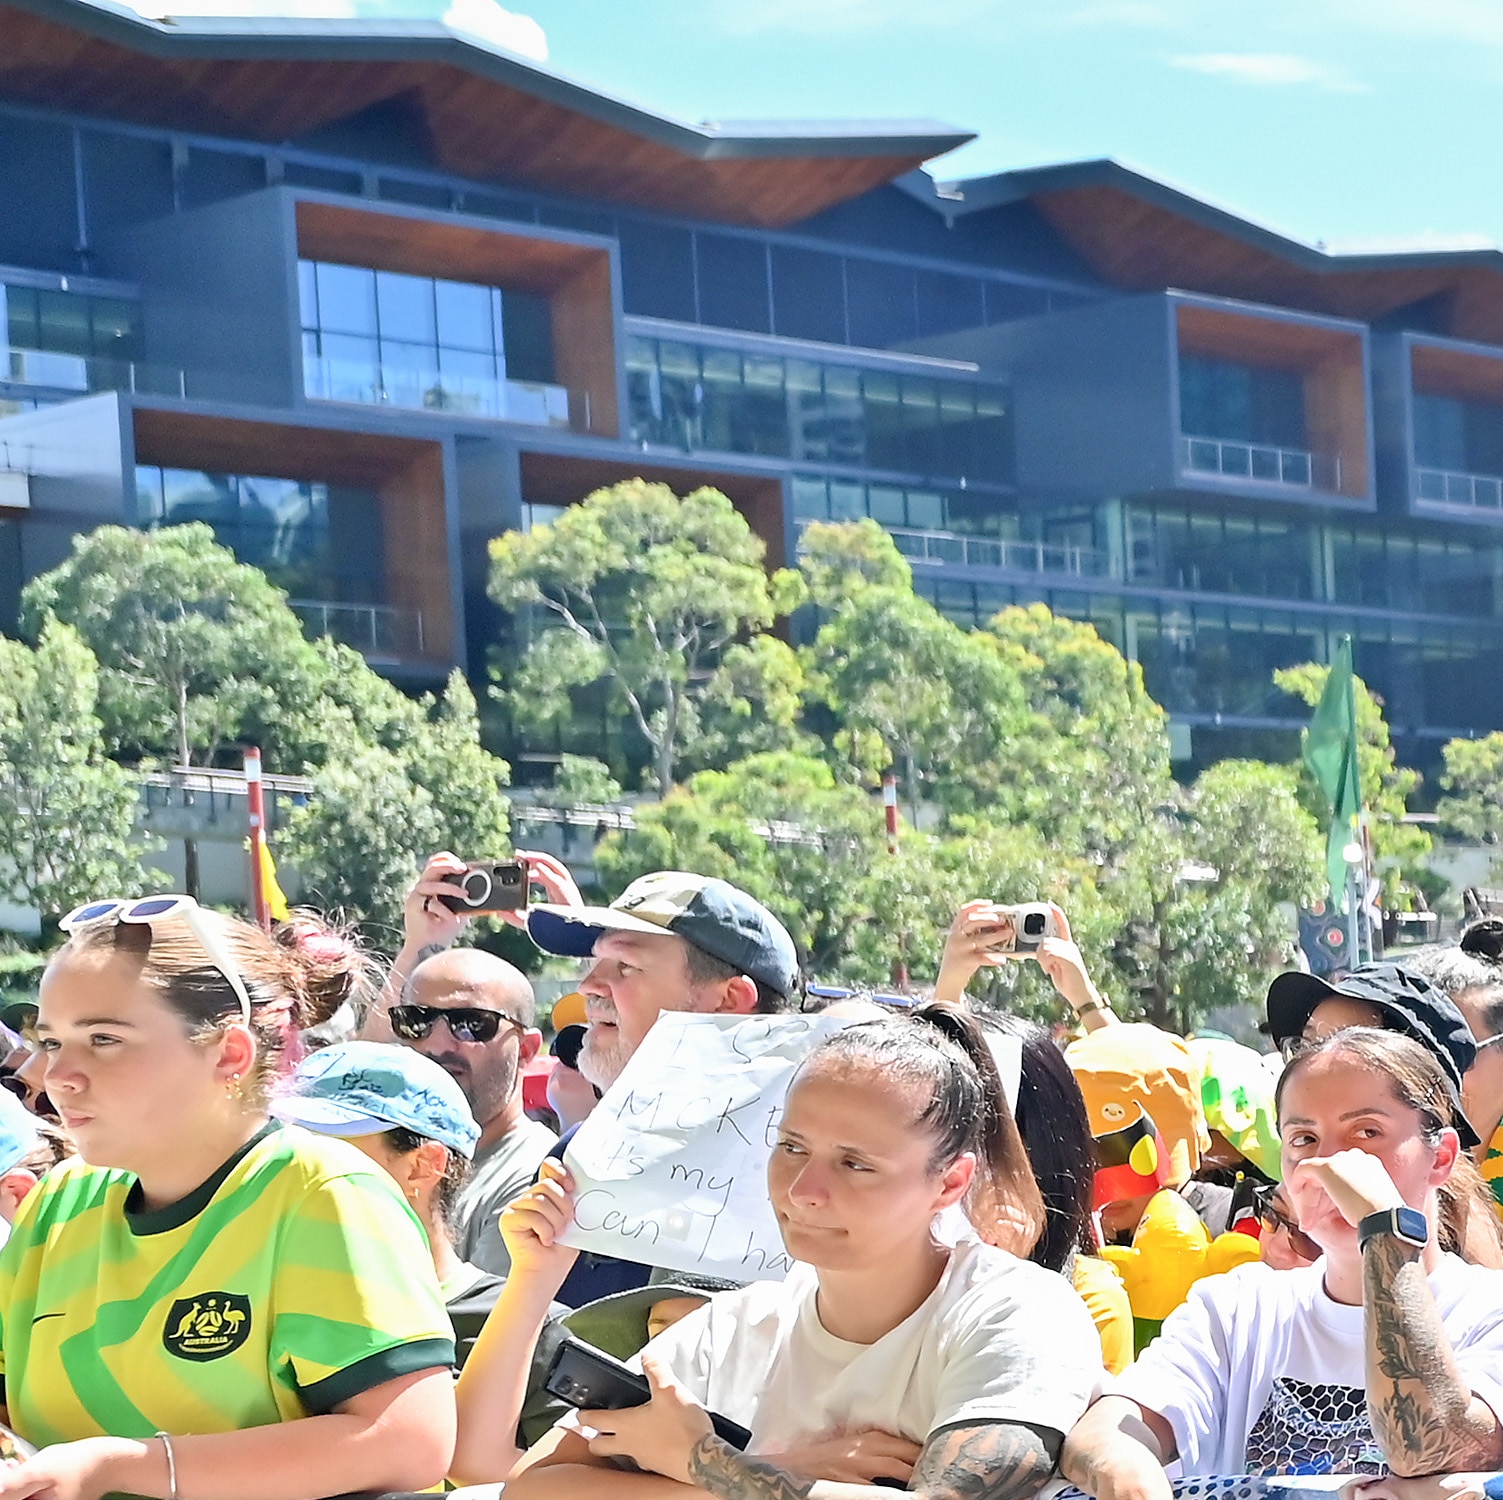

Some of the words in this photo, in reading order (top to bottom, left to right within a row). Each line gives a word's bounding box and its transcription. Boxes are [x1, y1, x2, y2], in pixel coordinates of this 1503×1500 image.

[616, 1088, 784, 1149] MCKE
[669, 1163, 735, 1218] my
[573, 1189, 660, 1245] Can
[741, 1231, 796, 1273] ha
